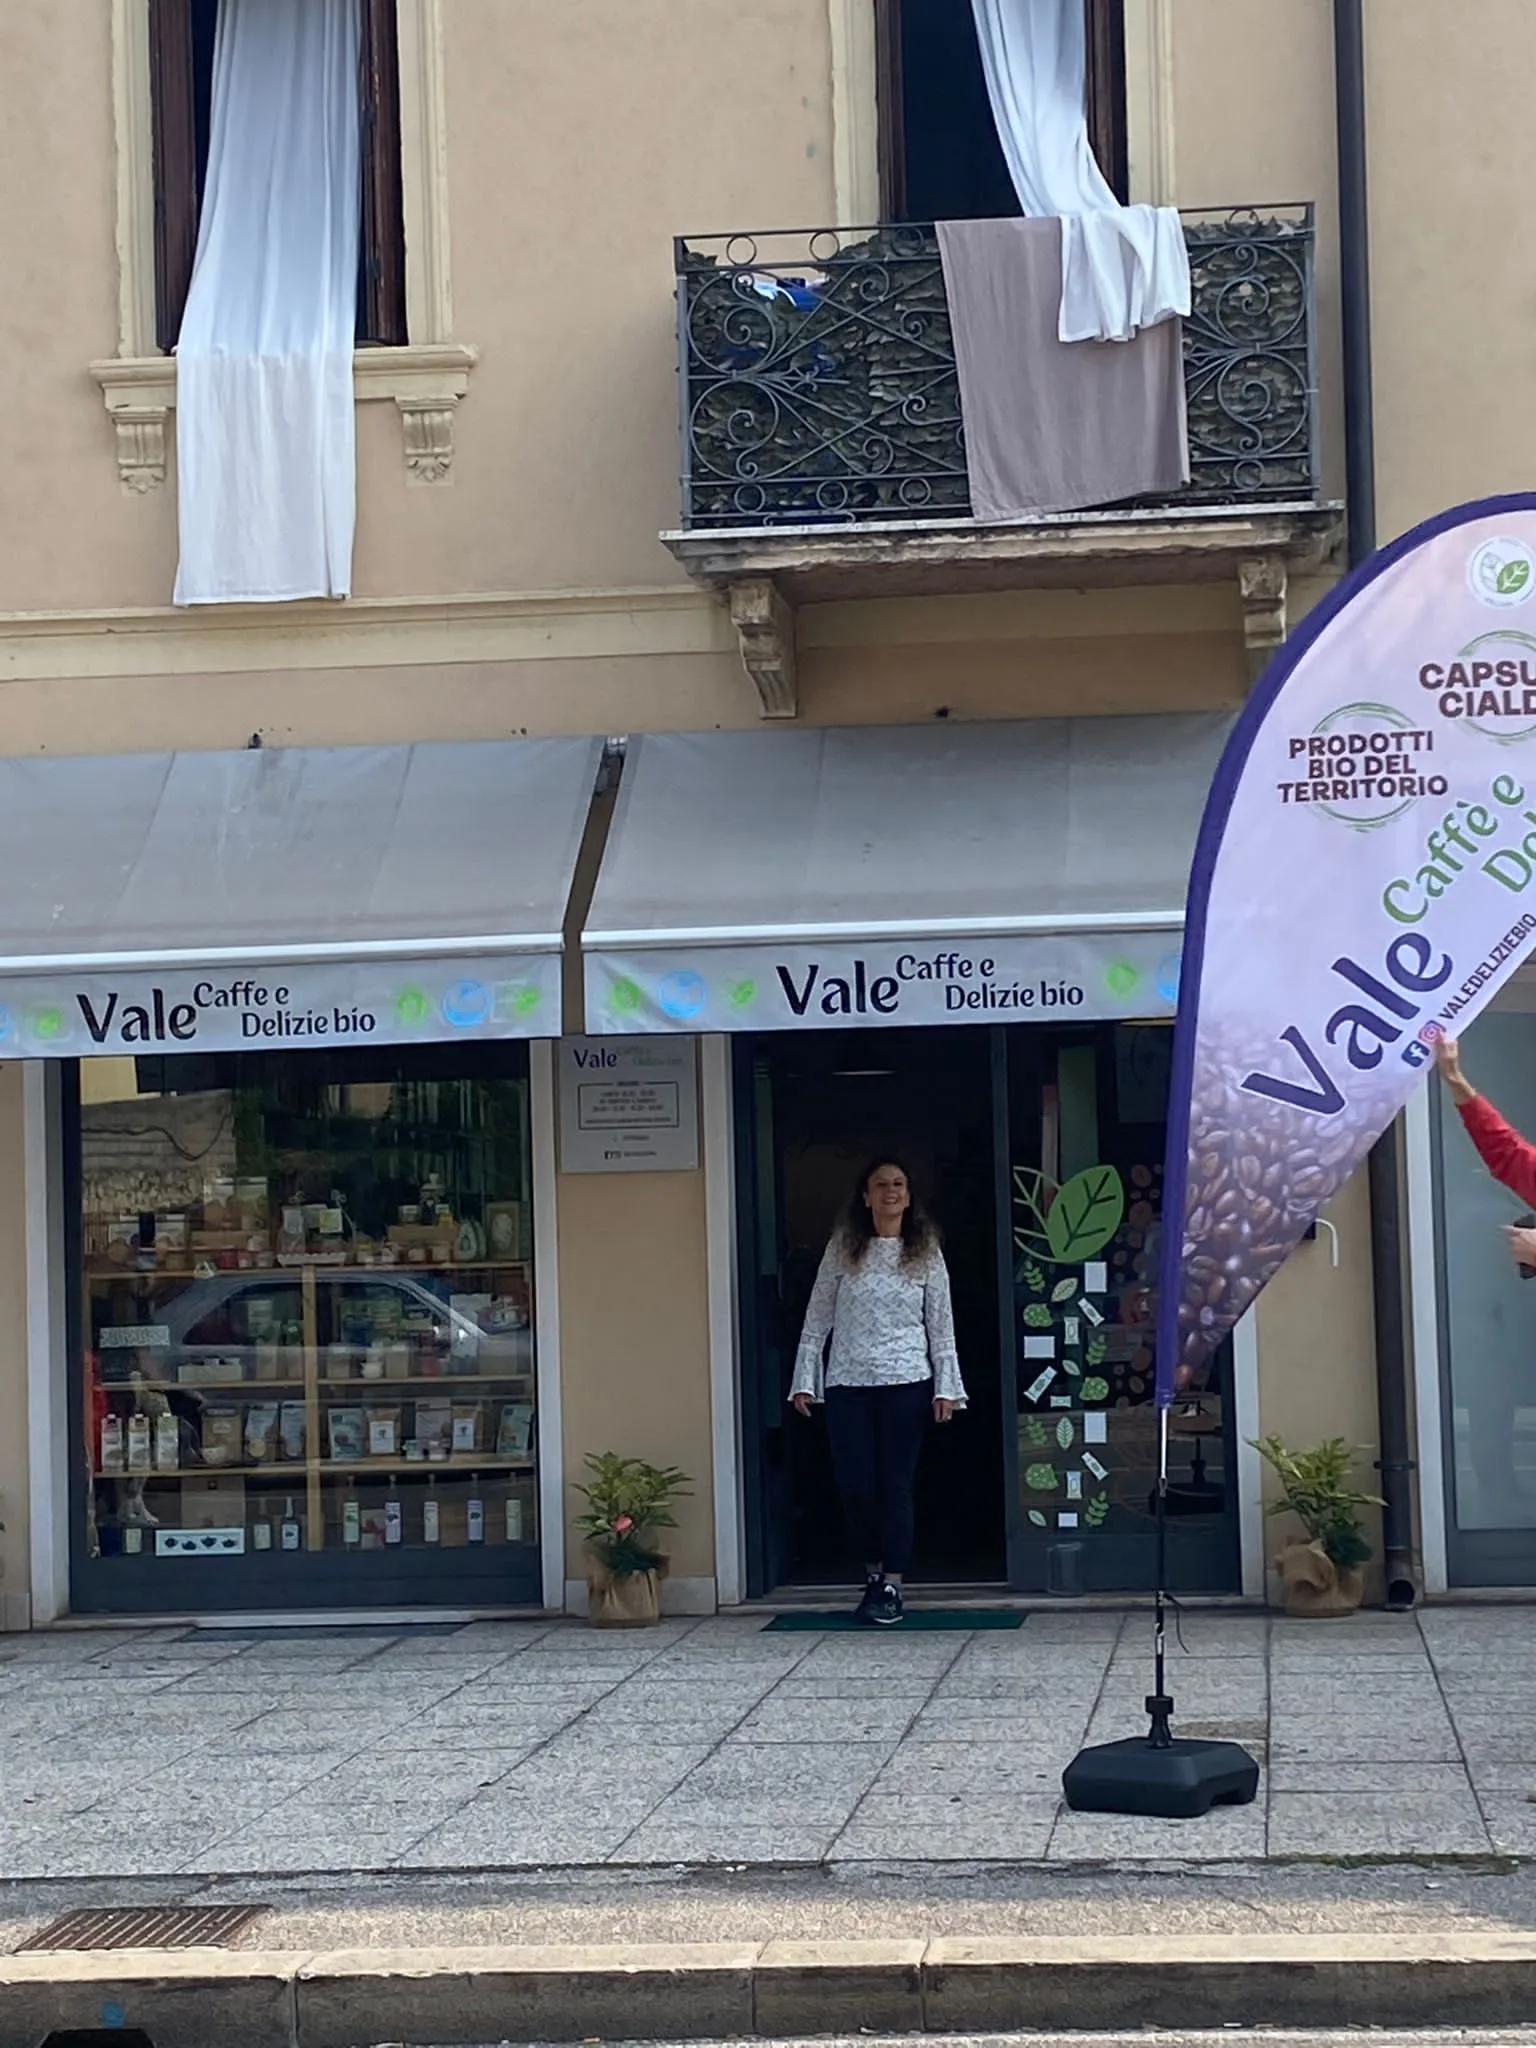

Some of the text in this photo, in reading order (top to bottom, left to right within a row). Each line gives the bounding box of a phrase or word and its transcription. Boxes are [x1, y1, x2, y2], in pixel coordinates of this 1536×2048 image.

[1288, 730, 1434, 759] PRODOTTI
[1308, 754, 1416, 779] BIO DEL
[1277, 775, 1448, 803] TERRITORIO
[1382, 800, 1498, 924] Caffè
[1493, 774, 1525, 806] e
[896, 953, 995, 980] Caffe e
[1438, 913, 1536, 1020] VALEDELIZIEBIO
[194, 981, 289, 1008] Caffe e
[776, 960, 899, 1016] Vale
[945, 980, 1084, 1010] Delizie bio
[76, 987, 197, 1043] Vale
[241, 1007, 376, 1038] Delizie bio
[1240, 932, 1453, 1115] Vale
[573, 1048, 618, 1068] Vale
